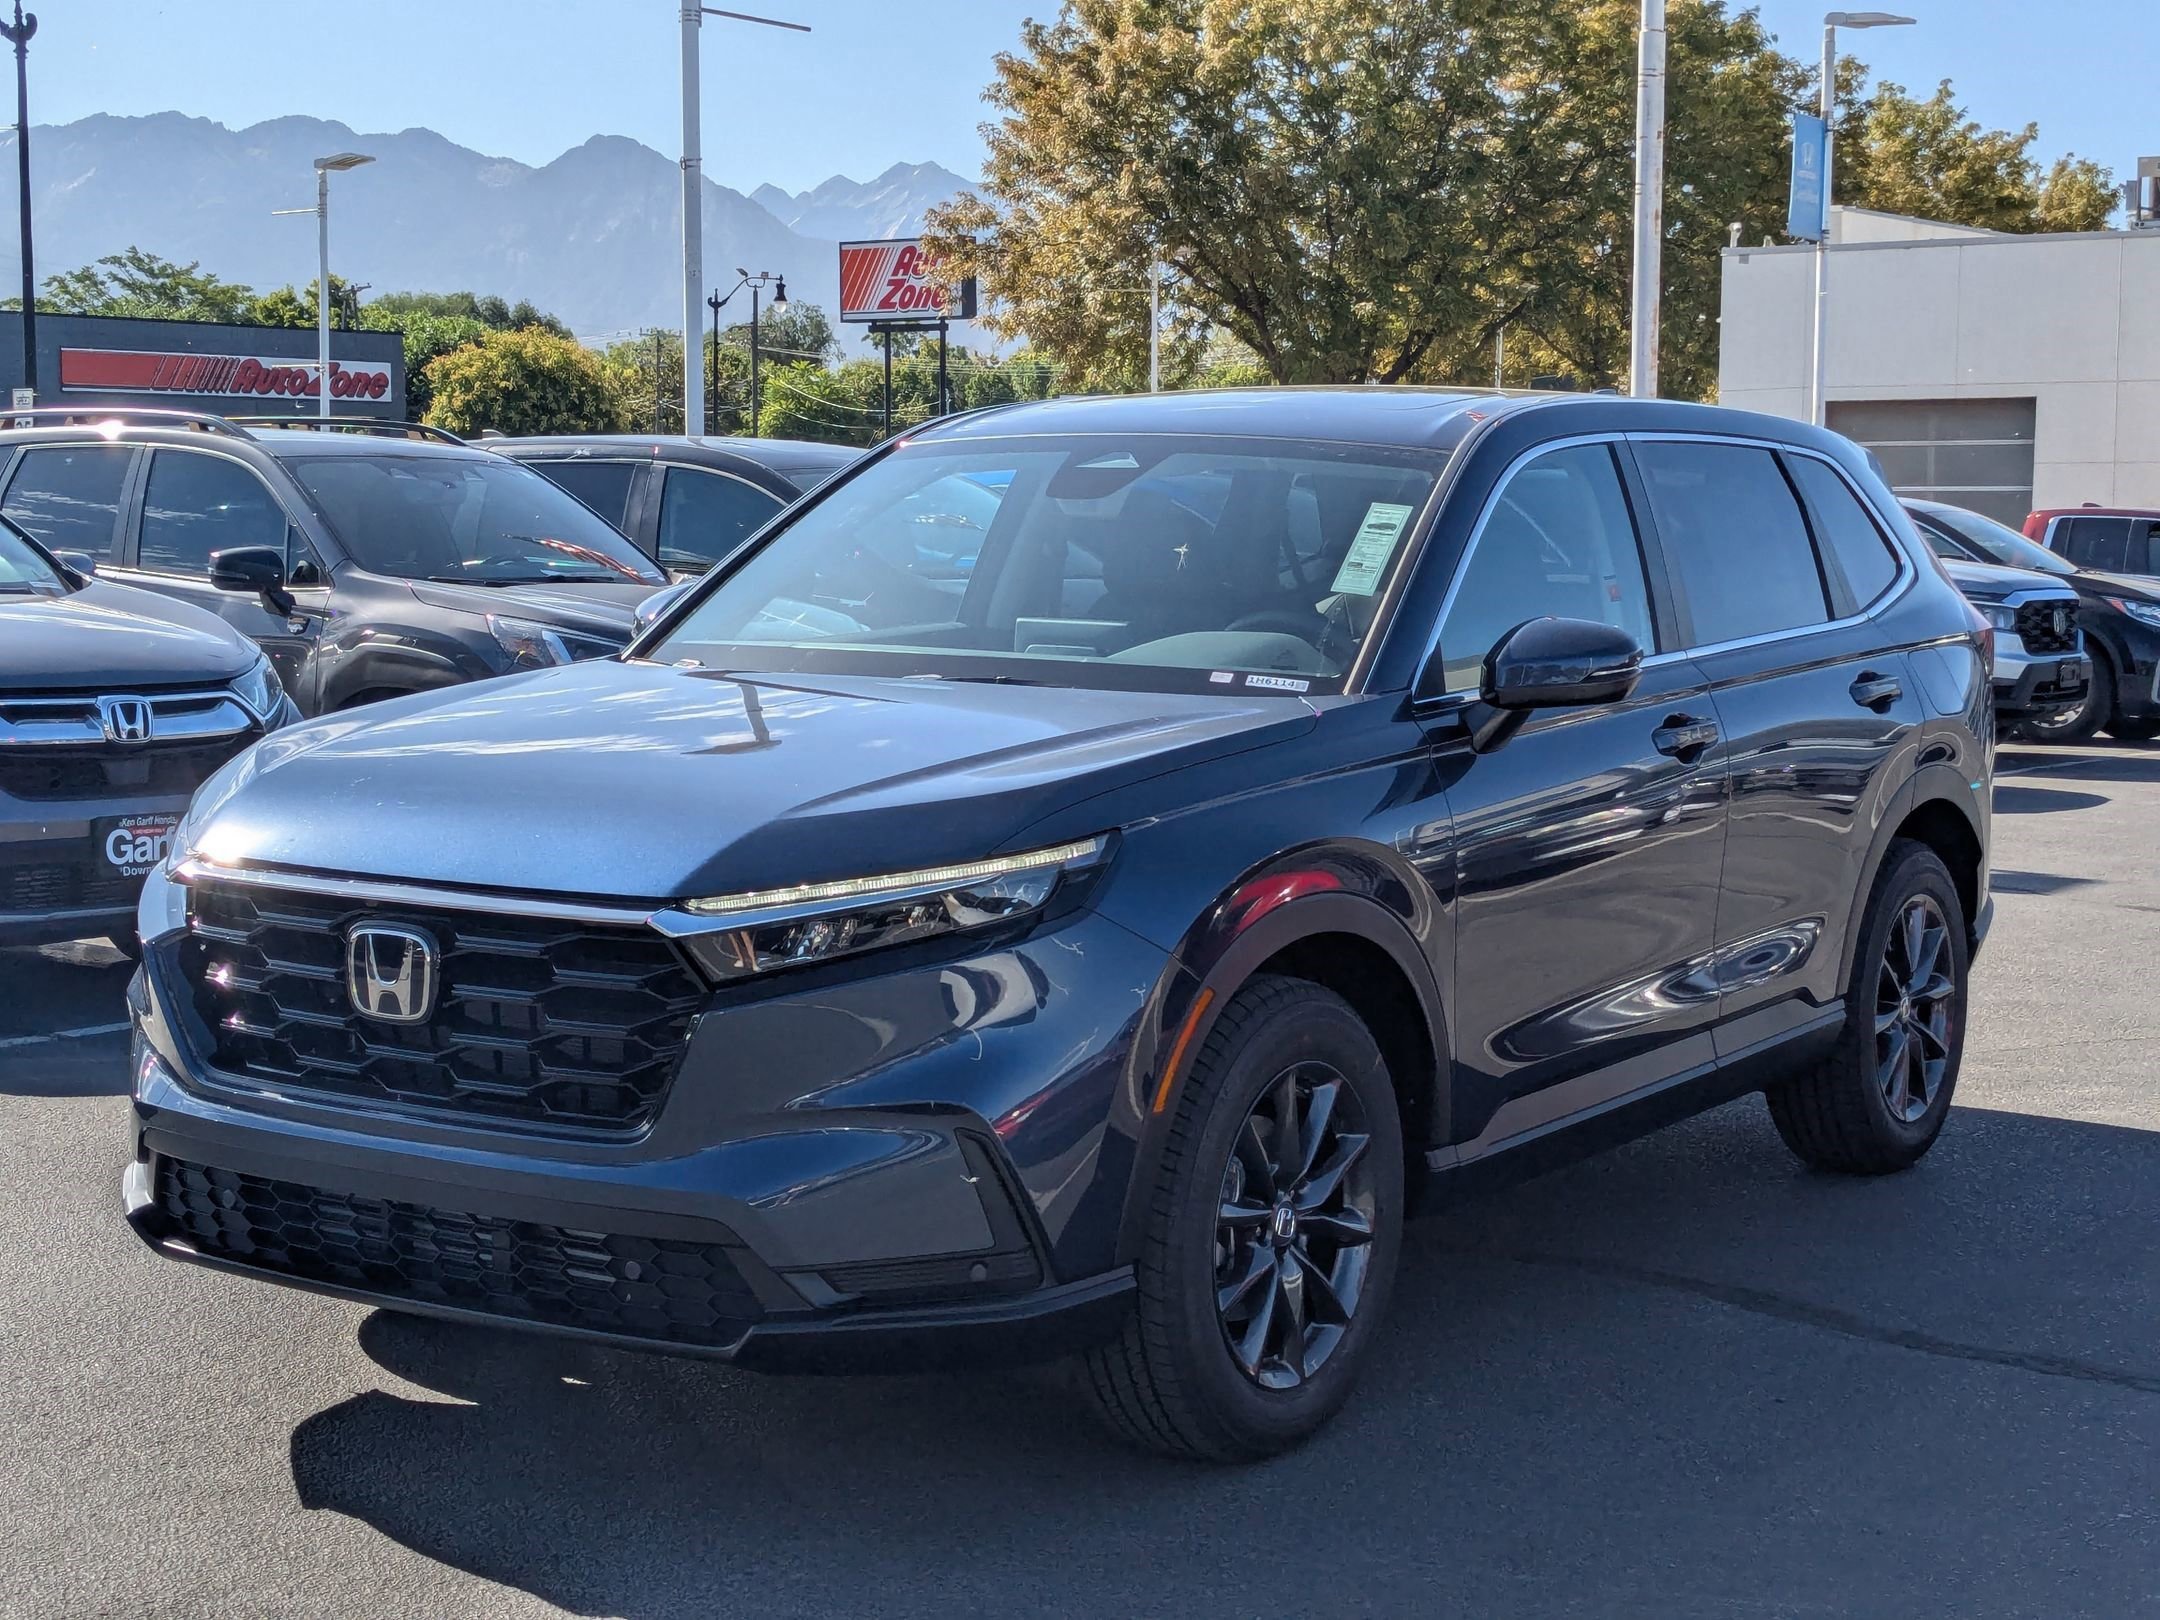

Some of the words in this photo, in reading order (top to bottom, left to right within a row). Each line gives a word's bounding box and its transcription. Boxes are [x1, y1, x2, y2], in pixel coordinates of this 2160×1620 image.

[877, 279, 946, 310] Zone
[229, 358, 390, 399] AutoZone
[121, 817, 135, 827] Ken
[136, 816, 153, 827] Garff
[106, 826, 176, 865] Garf
[123, 866, 153, 877] Down
